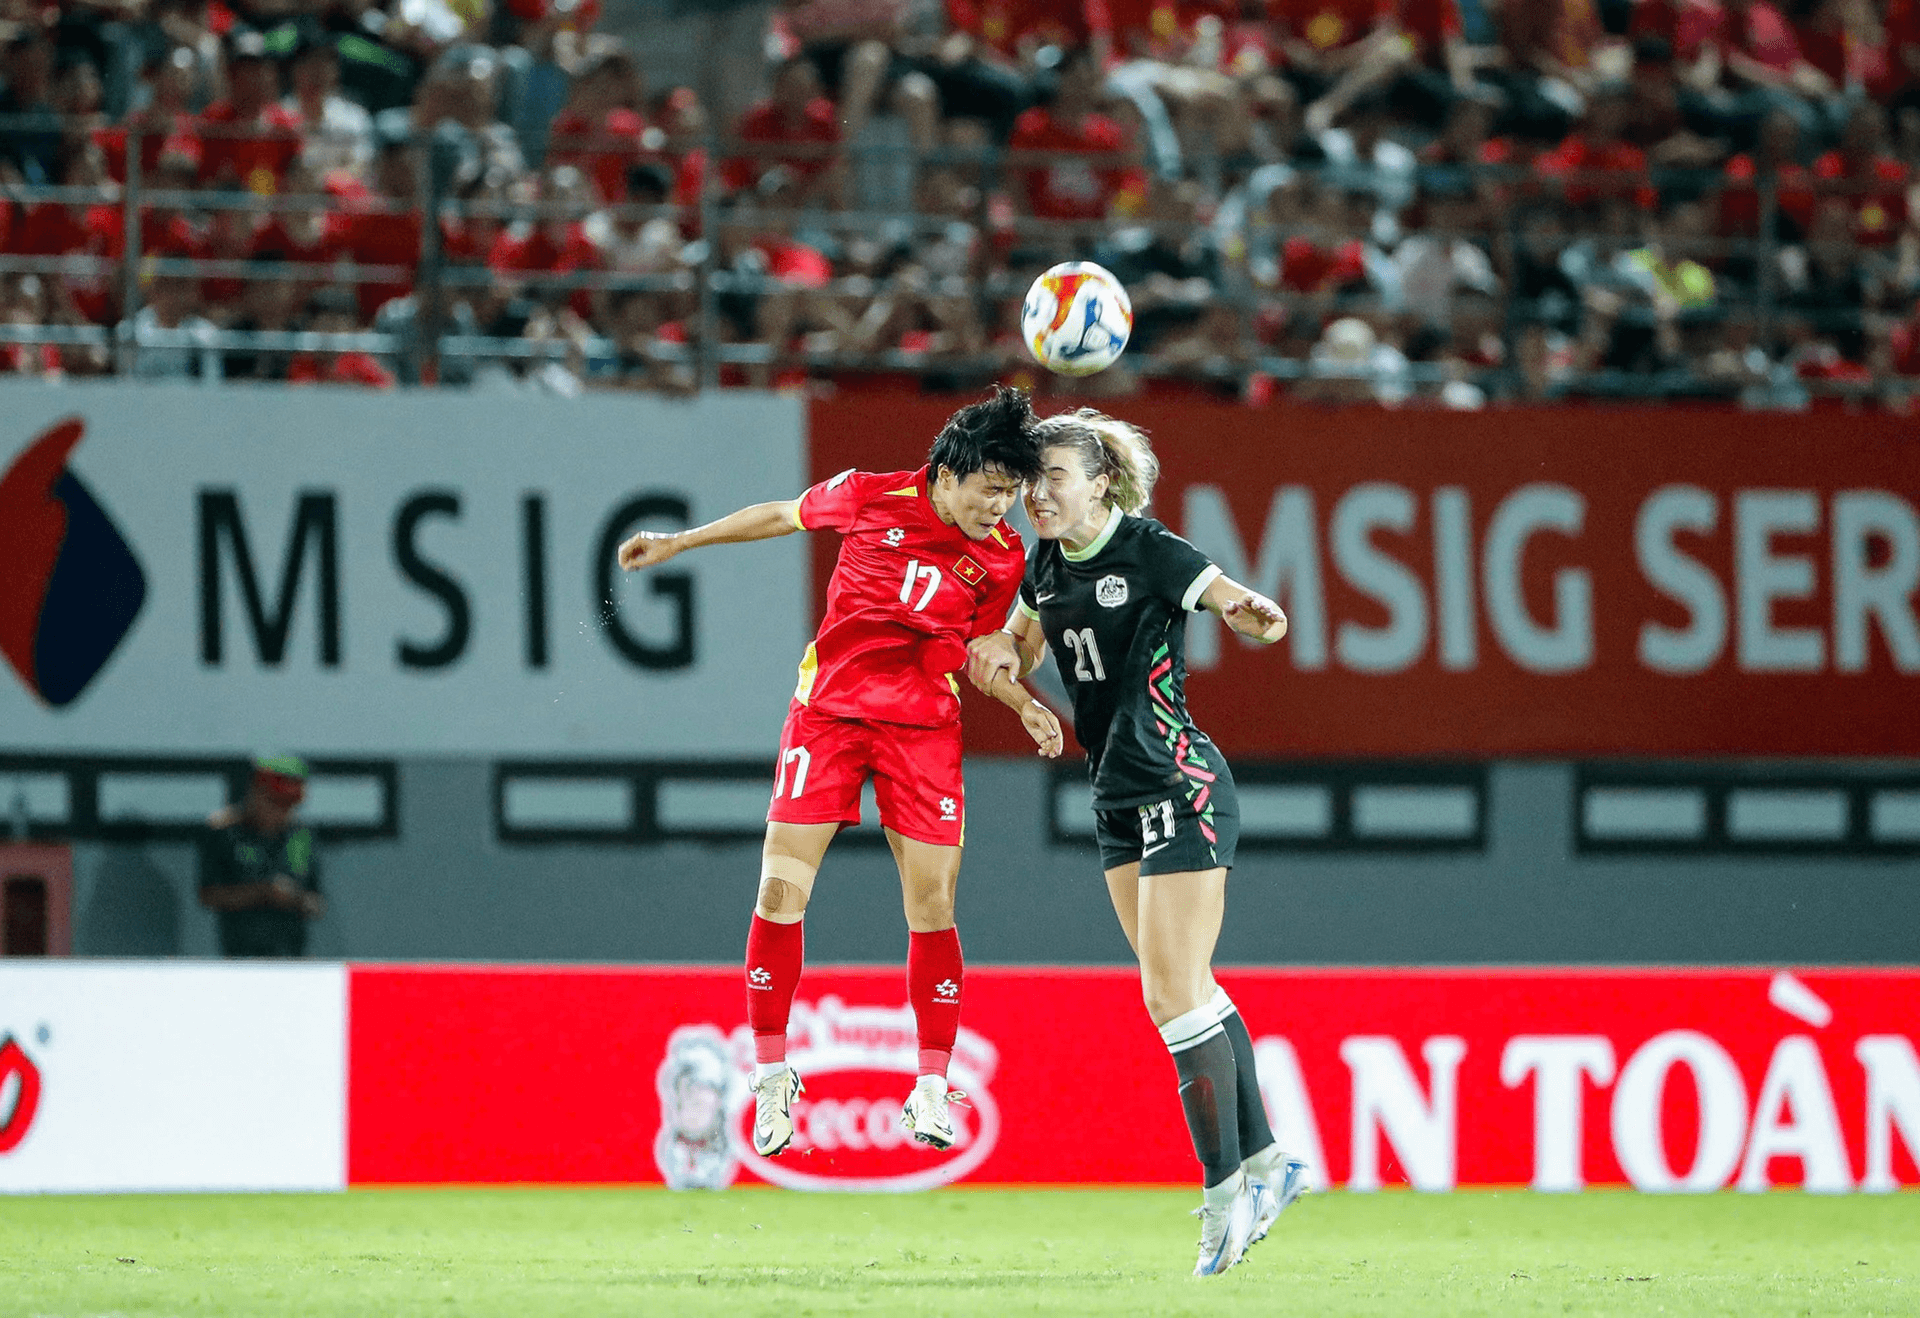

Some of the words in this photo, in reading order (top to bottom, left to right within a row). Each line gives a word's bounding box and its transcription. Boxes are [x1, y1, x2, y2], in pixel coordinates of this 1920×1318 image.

[200, 486, 699, 672] MSIG
[899, 559, 943, 612] 17
[1183, 484, 1593, 674] MSIG
[1063, 627, 1106, 682] 21
[775, 745, 811, 800] 17
[1138, 799, 1176, 845] 21
